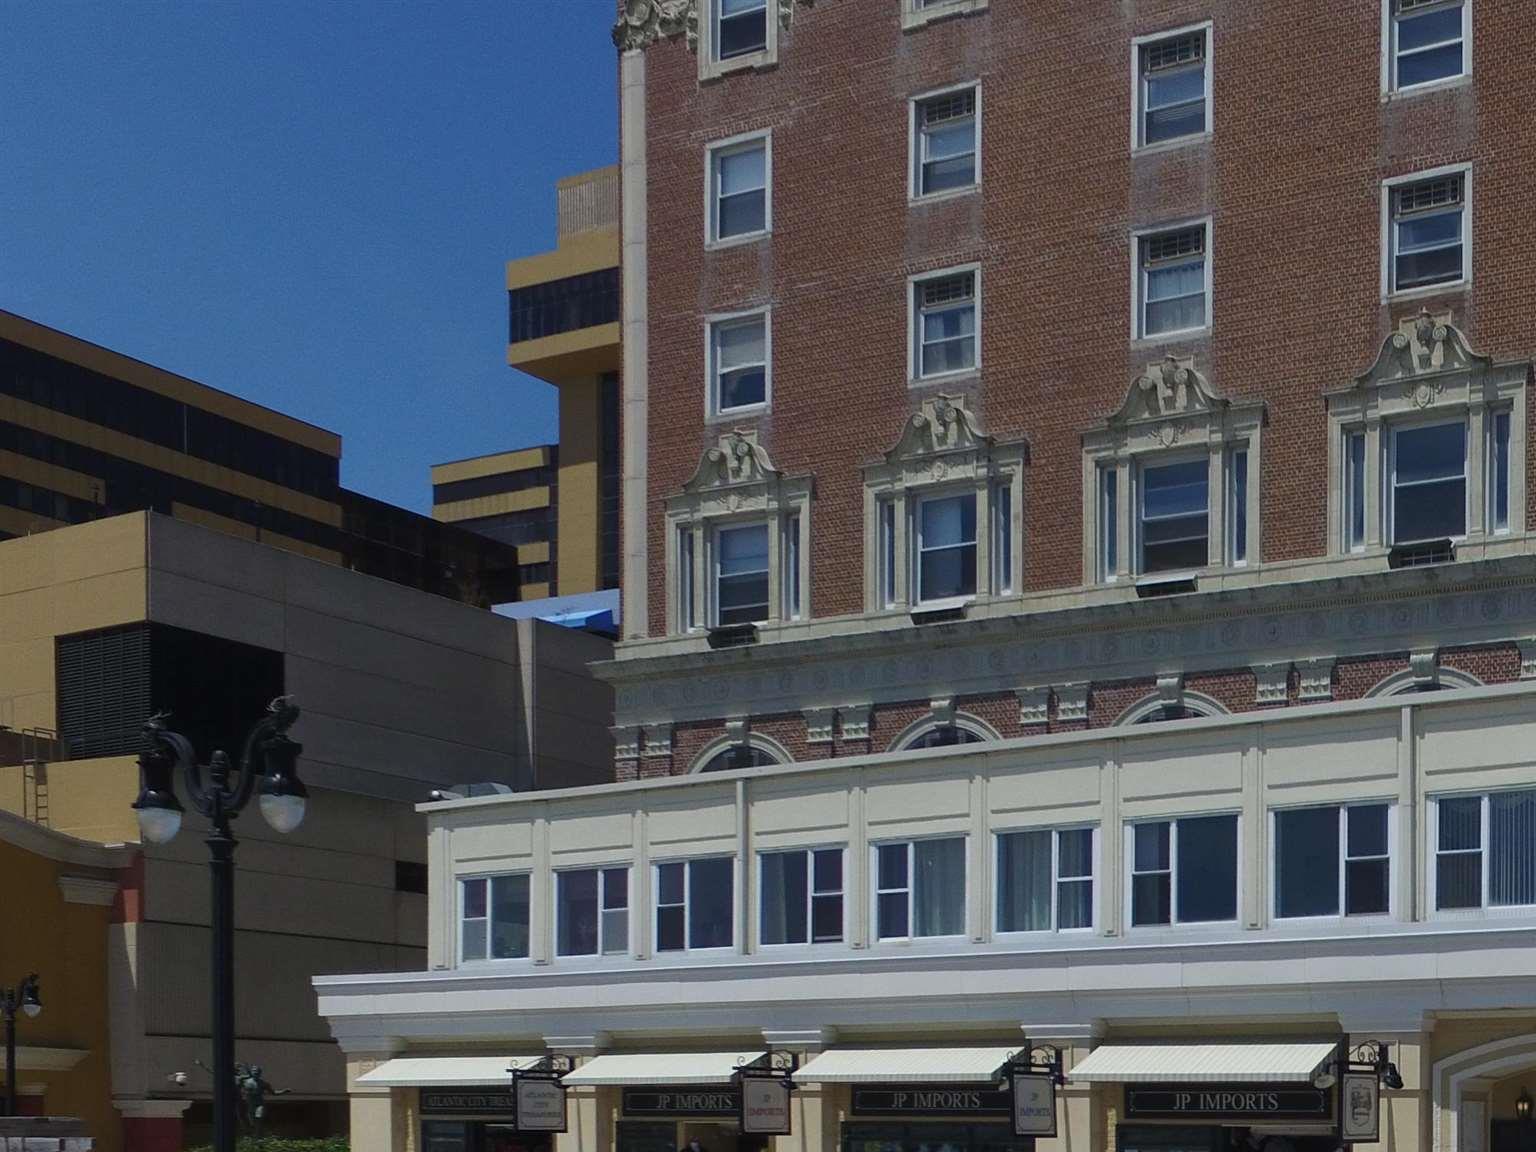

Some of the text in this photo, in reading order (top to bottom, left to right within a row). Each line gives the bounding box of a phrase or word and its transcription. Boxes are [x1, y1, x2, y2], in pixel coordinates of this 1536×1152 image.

[656, 1095, 733, 1110] JP IMPORTS
[891, 1092, 980, 1108] JP IMPORTS
[1172, 1093, 1279, 1111] JP IMPORTS
